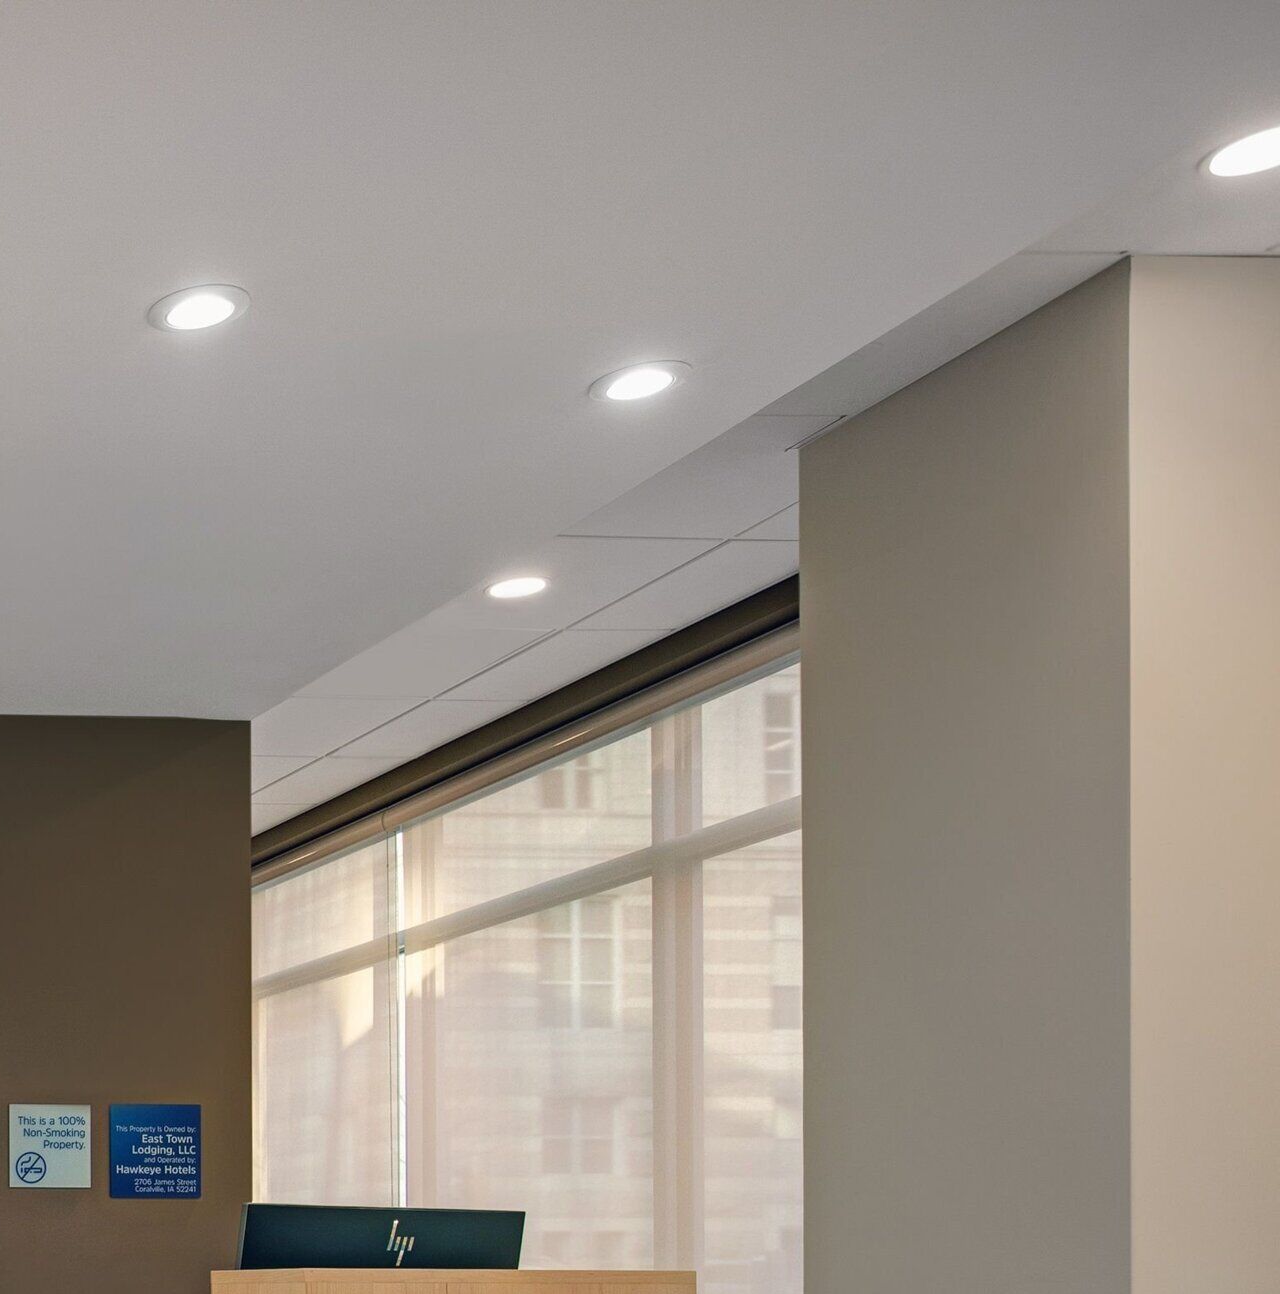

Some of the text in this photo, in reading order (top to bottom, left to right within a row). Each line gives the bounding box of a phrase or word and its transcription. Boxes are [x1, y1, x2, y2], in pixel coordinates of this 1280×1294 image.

[18, 1116, 36, 1125] This
[39, 1116, 46, 1125] is
[59, 1116, 86, 1125] 100%
[23, 1128, 86, 1138] Non-Smoking
[129, 1125, 156, 1133] Property
[141, 1134, 193, 1144] East Town
[43, 1140, 86, 1150] Property.
[132, 1145, 196, 1156] Lodging, LLC
[157, 1156, 186, 1164] Operated
[116, 1165, 196, 1175] Hawkeye Hotels
[135, 1185, 166, 1193] Coralville,
